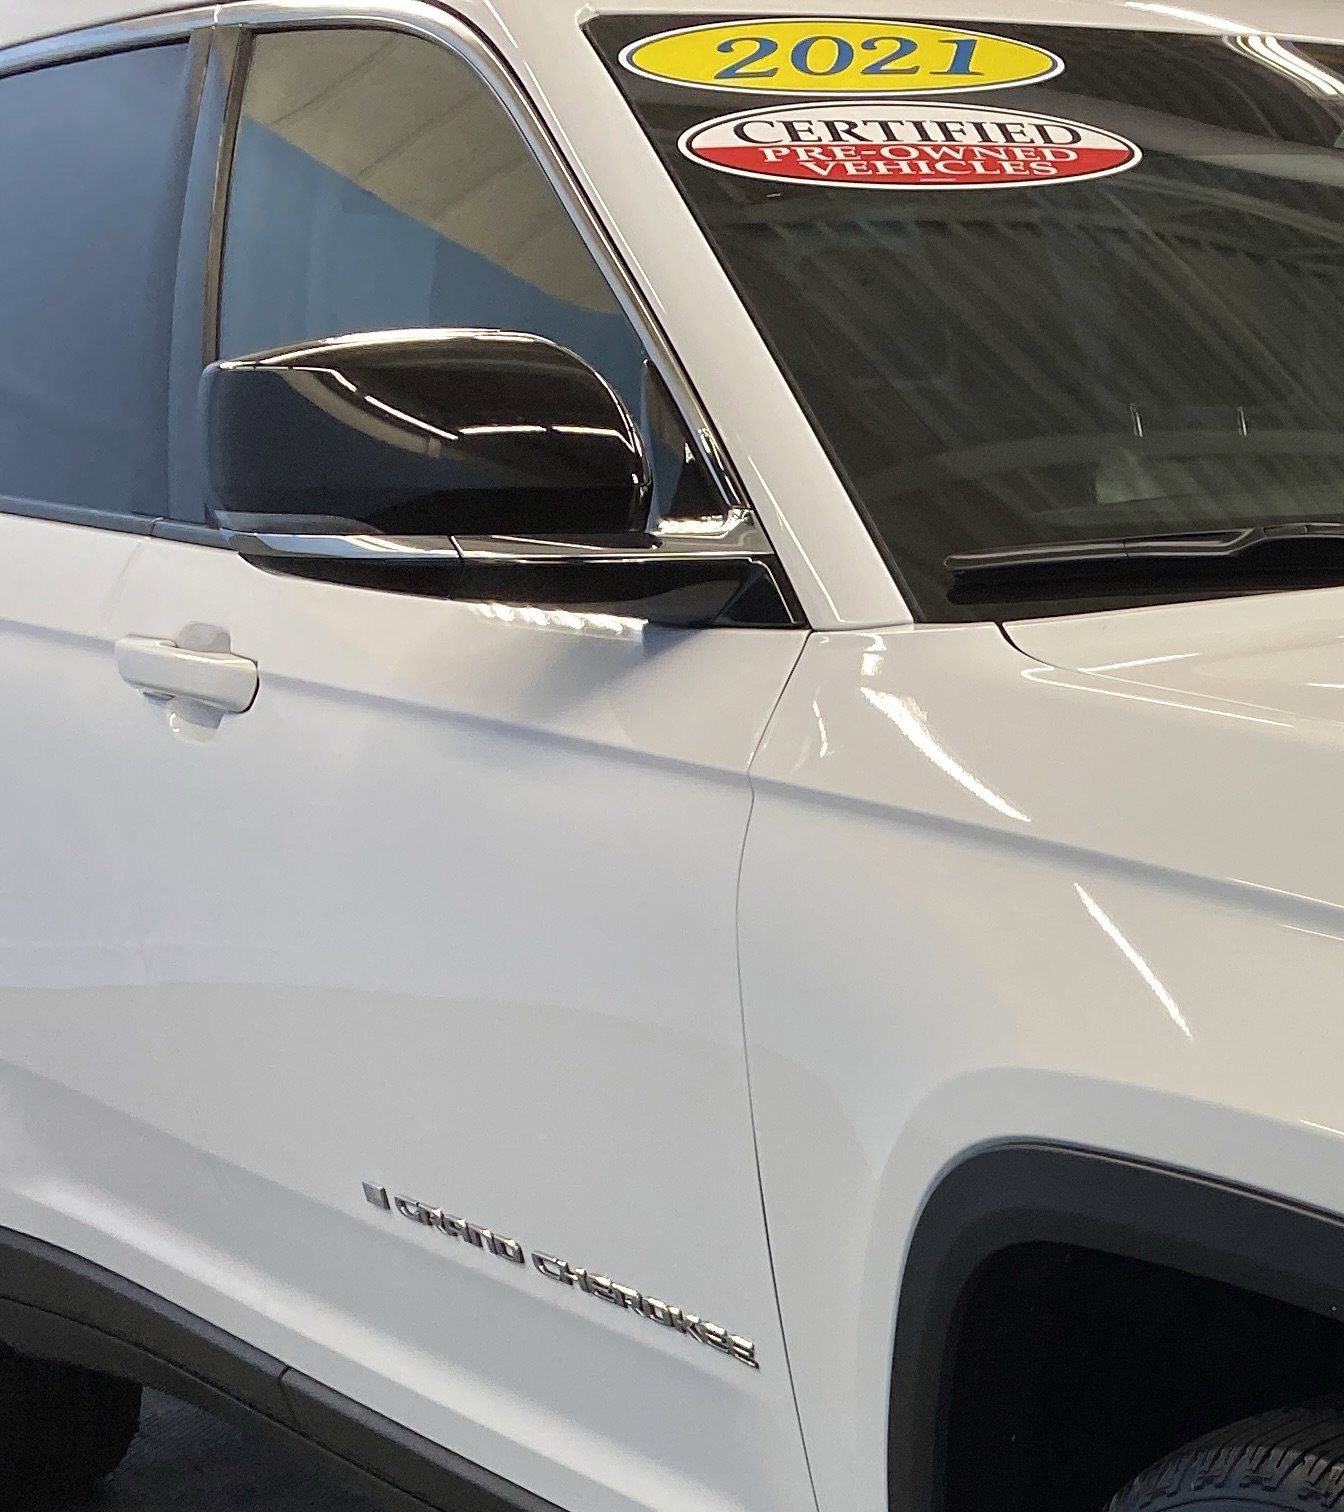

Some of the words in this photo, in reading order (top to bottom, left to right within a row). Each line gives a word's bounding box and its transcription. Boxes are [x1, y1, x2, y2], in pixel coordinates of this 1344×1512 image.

[714, 35, 985, 79] 2021
[732, 119, 1082, 146] CERTIFIED
[763, 145, 1078, 163] PRE-OWNED
[798, 160, 1058, 177] VEHICLES
[394, 1194, 525, 1264] GRAND
[531, 1250, 760, 1370] CHEROKEE
